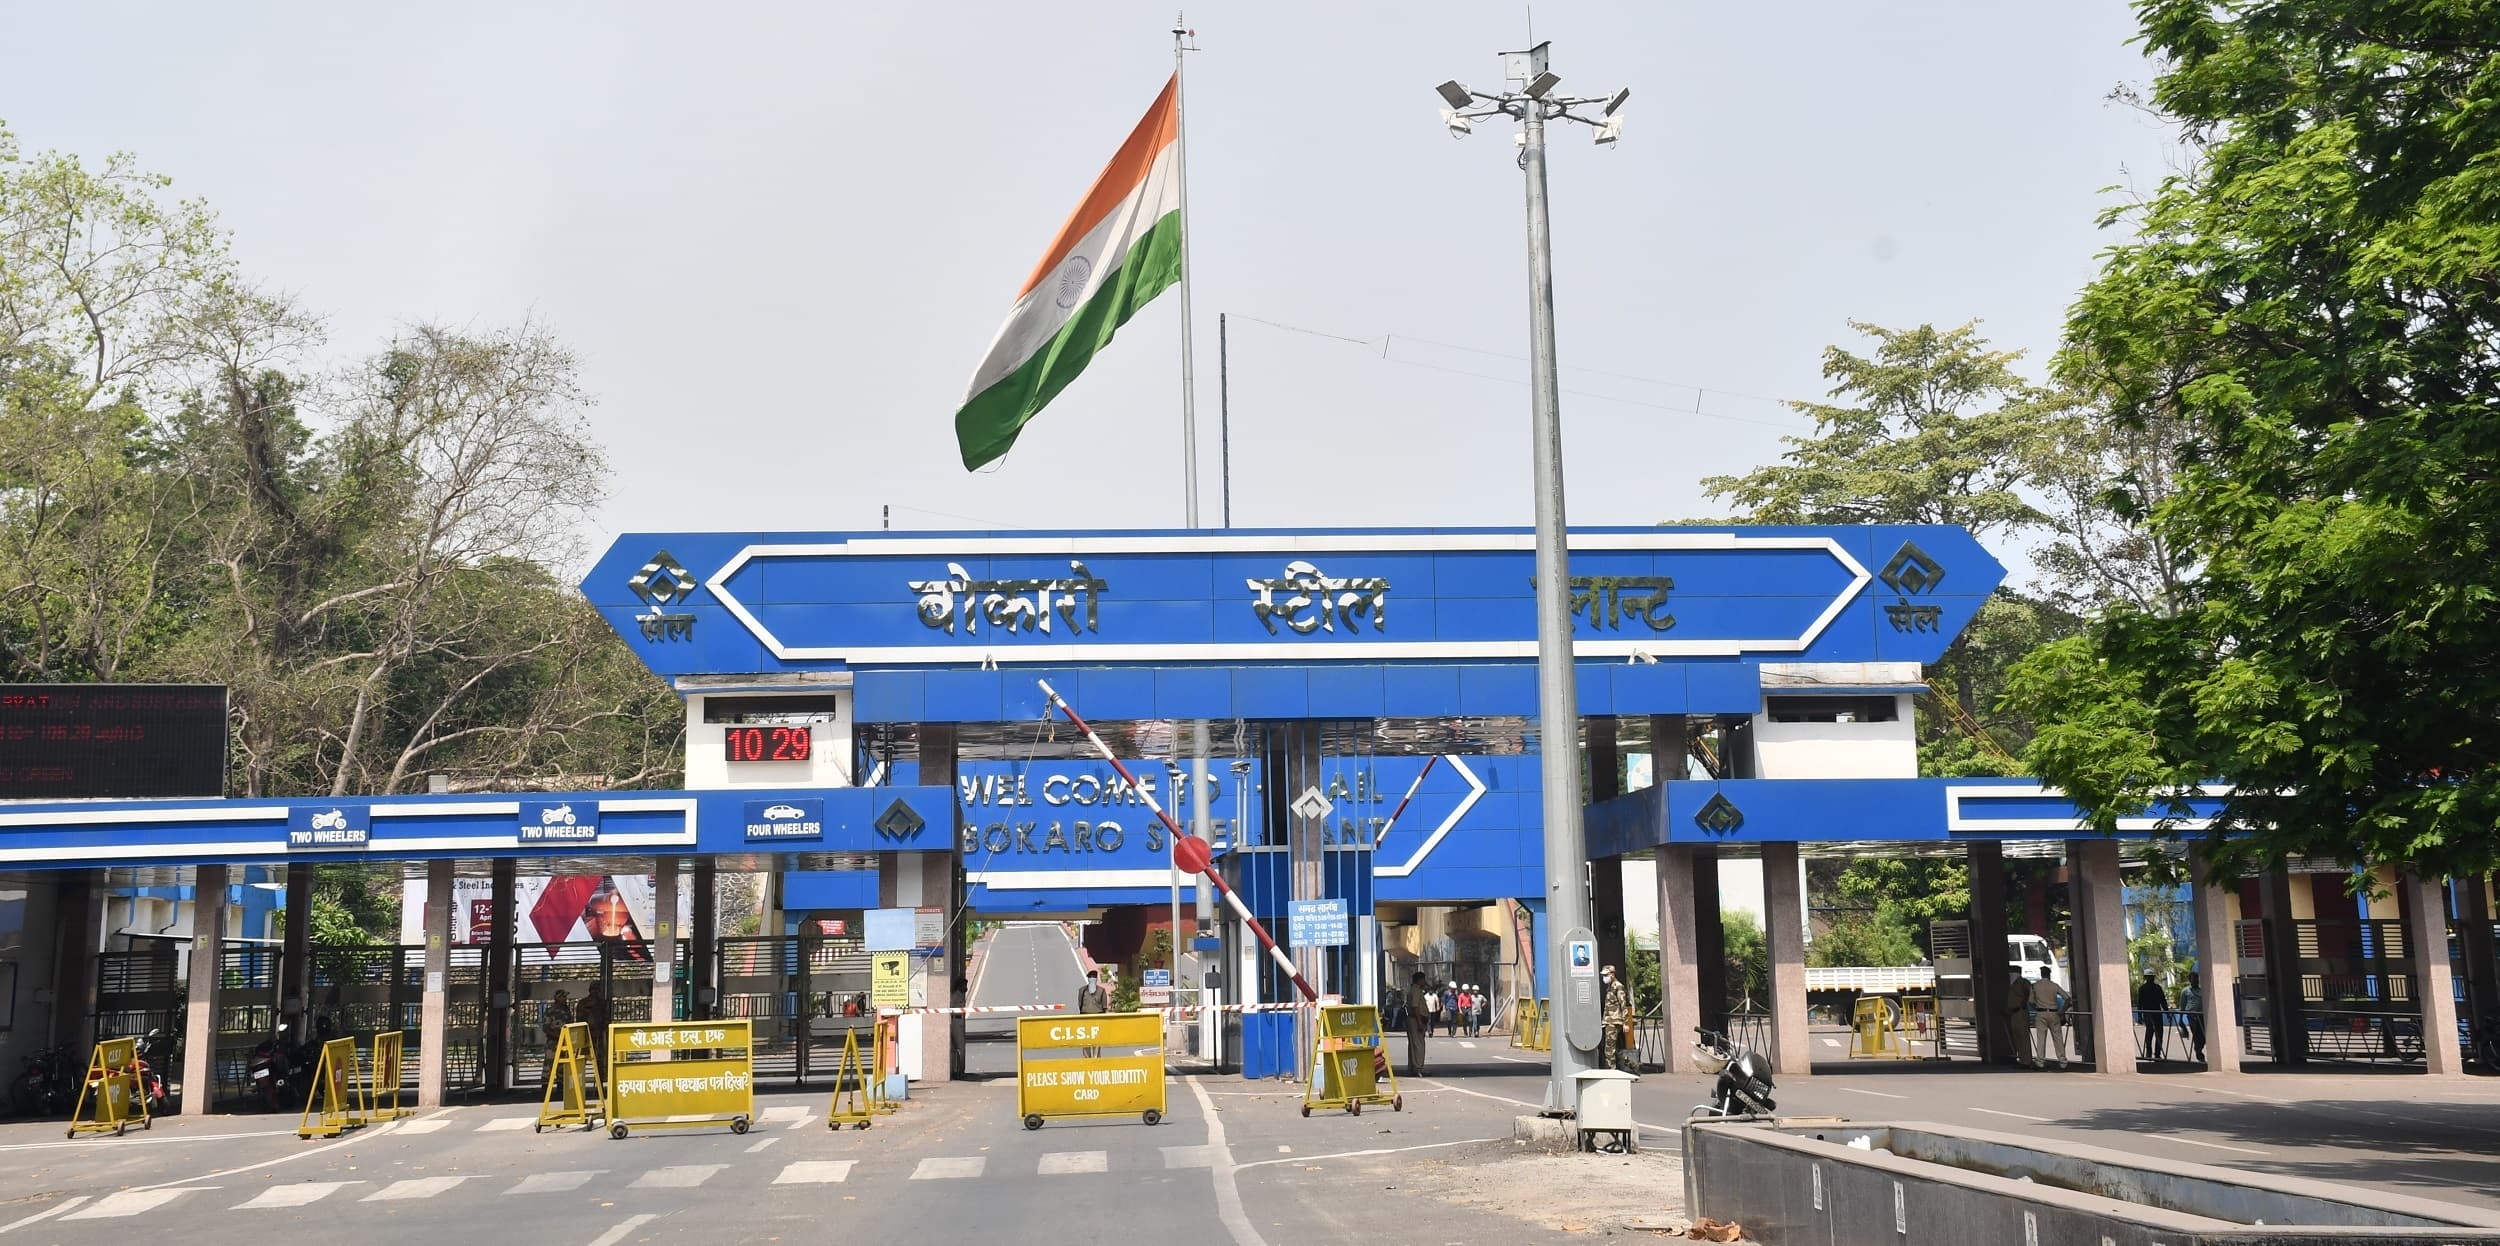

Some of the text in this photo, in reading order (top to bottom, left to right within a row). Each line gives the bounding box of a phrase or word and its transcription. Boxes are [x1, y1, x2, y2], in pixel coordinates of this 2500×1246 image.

[908, 561, 1109, 635] बोकारो
[1246, 560, 1391, 636] स्टील
[635, 606, 697, 643] सेल
[1883, 597, 1944, 634] सेल
[290, 830, 366, 844] TWO WHEELERS
[521, 825, 595, 838] TWO WHEELERS
[747, 822, 820, 836] FOUR WHEELERS
[963, 820, 1123, 854] BOKARO
[459, 880, 479, 889] Steel
[618, 1080, 646, 1098] कृपया
[647, 1078, 673, 1095] अपना
[674, 1077, 708, 1093] पहचान
[710, 1076, 723, 1090] पत्र
[1027, 1069, 1148, 1088] PLEASE SHOW YOUR IDENTITY
[1073, 1088, 1099, 1101] CARD
